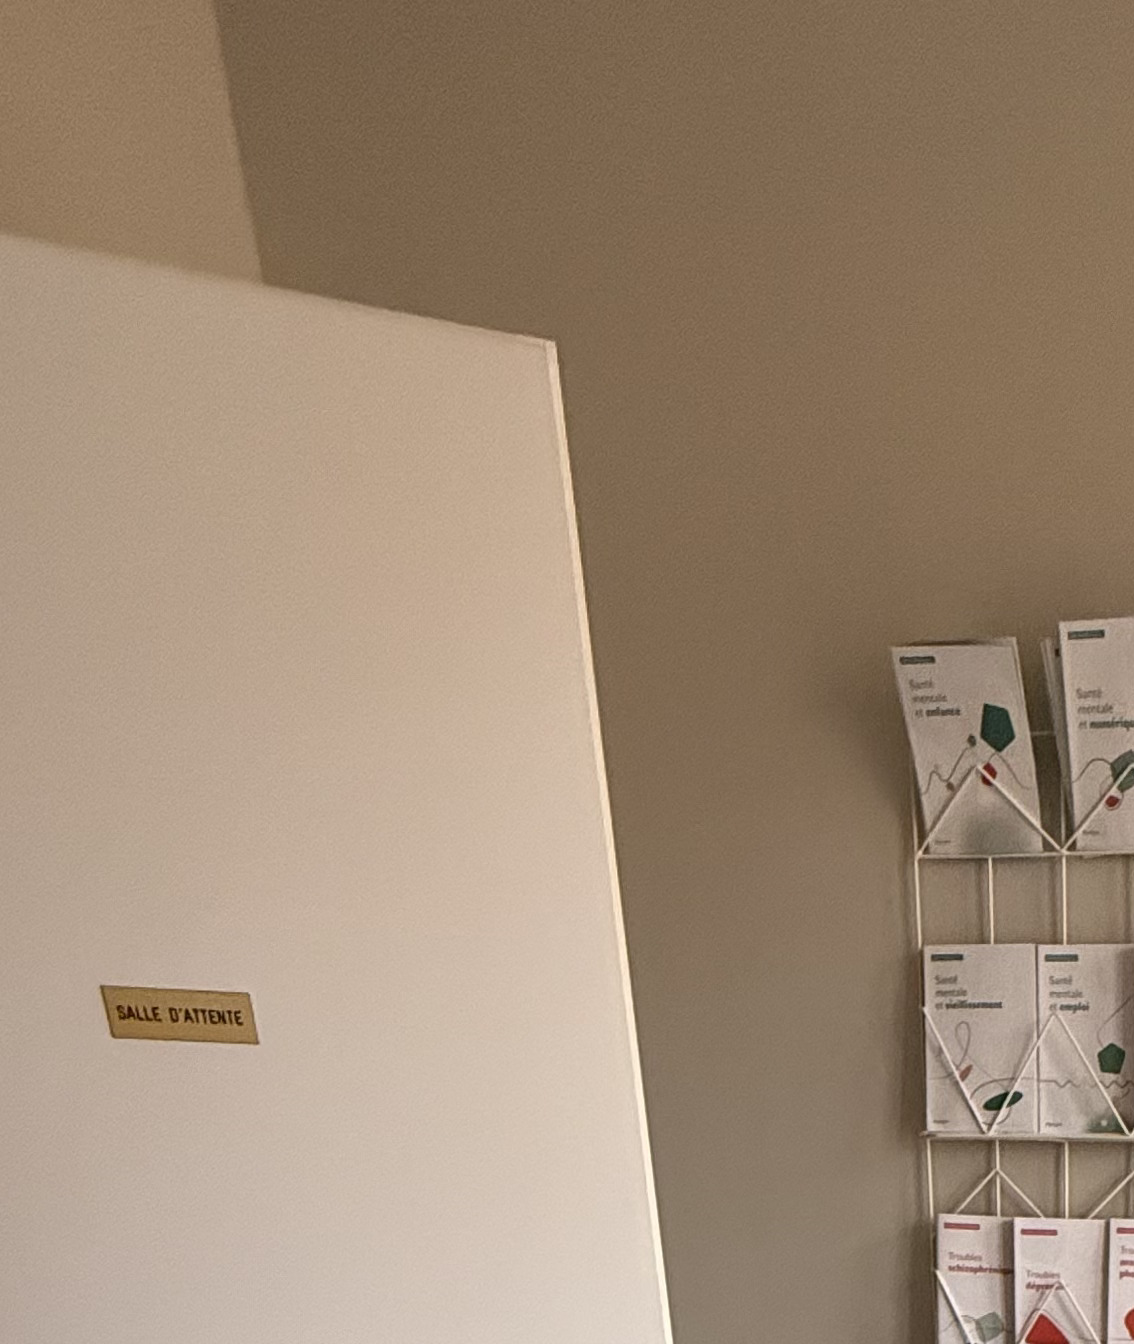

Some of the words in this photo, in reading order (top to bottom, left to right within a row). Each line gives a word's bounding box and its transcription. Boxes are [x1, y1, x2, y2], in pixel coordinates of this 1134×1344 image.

[116, 1004, 163, 1023] SALLE
[168, 1007, 245, 1026] D'ATTENTE
[1059, 1001, 1090, 1014] emploi
